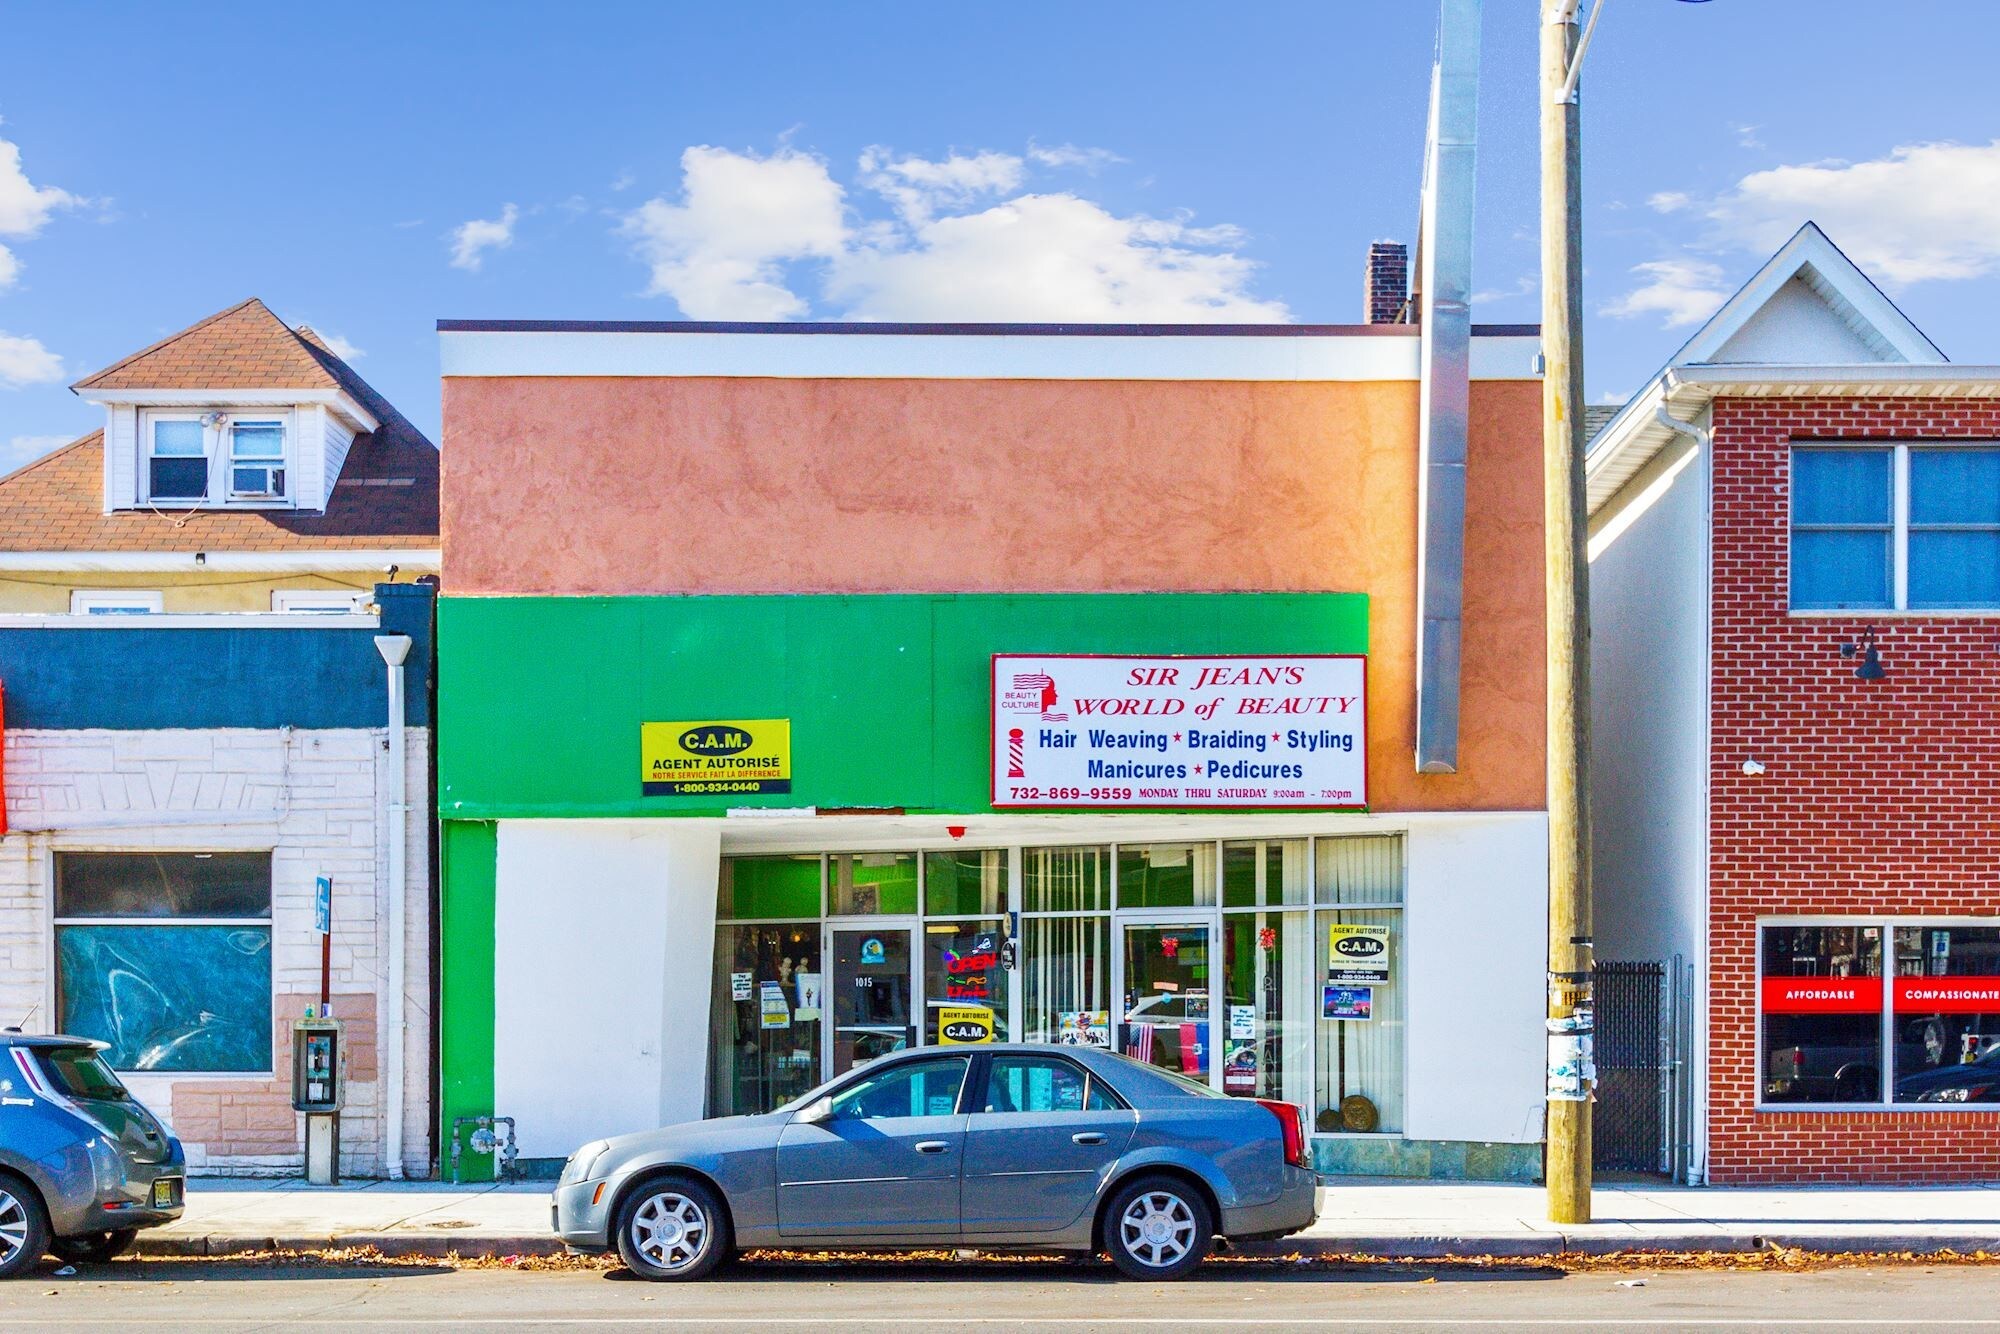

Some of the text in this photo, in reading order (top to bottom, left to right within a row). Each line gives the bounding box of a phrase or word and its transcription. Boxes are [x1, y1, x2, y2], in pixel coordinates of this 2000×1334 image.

[1127, 666, 1304, 690] SIR JEAN'S
[1002, 701, 1039, 709] CULTURE
[1073, 696, 1358, 720] WORLD of BEAUTY
[685, 733, 747, 749] C.A.M.
[1039, 729, 1352, 753] Hair Weaving Braiding Styling
[653, 754, 779, 769] AGENT AUTORISÉ
[652, 769, 781, 779] NOTRE SERVICE FAIT LA DIFFERENCE
[1088, 759, 1303, 779] Manicures Pedicures
[674, 782, 759, 793] 1-800-934-0440
[1010, 787, 1131, 800] 732-869-9559
[1139, 788, 1178, 798] MONDAY
[1185, 788, 1211, 798] THRU
[1217, 788, 1267, 798] SATURDAY
[1273, 790, 1304, 799] 9:00am
[1321, 789, 1352, 799] 7:00pm
[1338, 941, 1381, 952] C.A.M.
[947, 951, 997, 974] OPEN
[855, 977, 873, 987] 1015
[1786, 990, 1855, 999] AFFORDABLE
[1905, 990, 1999, 999] COMPASSIONATE
[946, 1026, 985, 1038] C.A.M.
